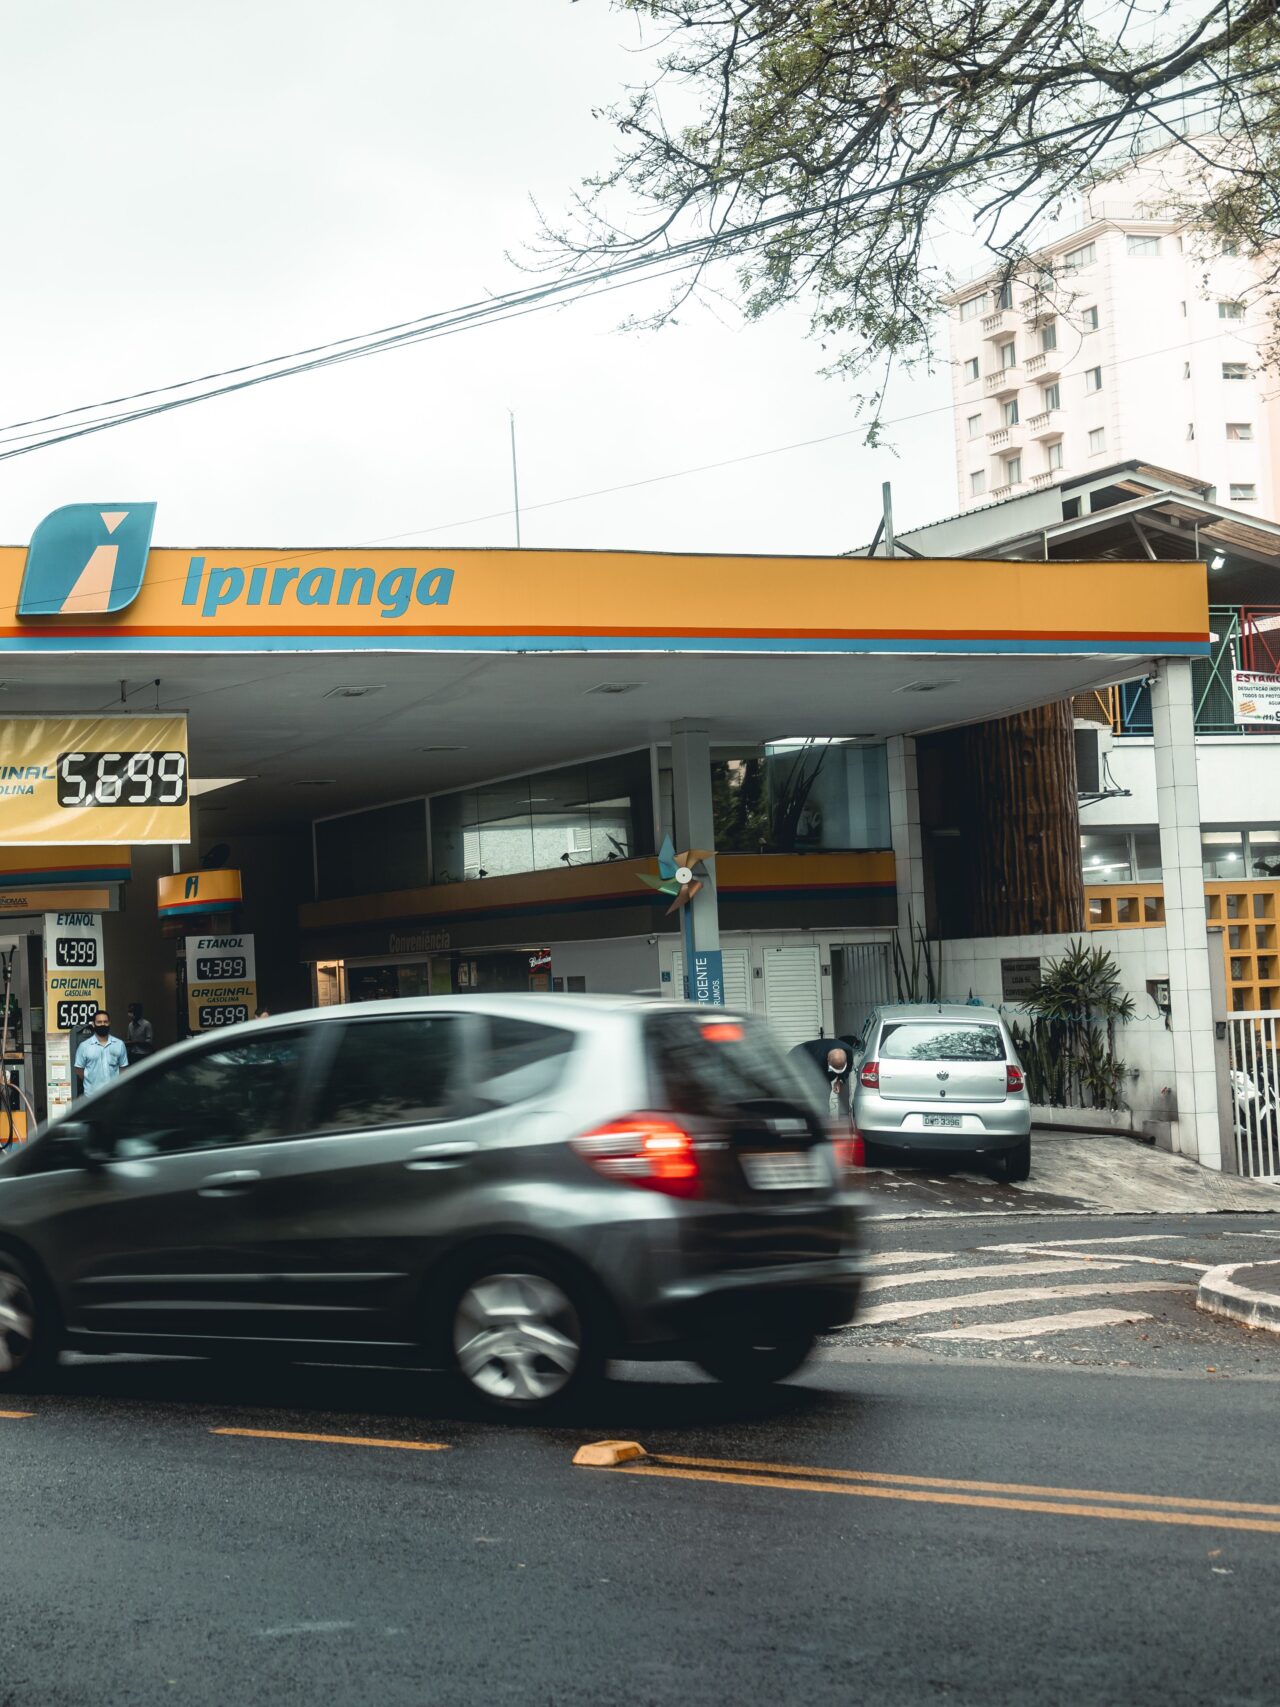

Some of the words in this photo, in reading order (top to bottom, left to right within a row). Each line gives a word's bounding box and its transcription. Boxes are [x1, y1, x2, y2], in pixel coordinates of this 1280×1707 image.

[181, 556, 456, 619] Ipiranga
[61, 752, 186, 807] 5,699
[56, 912, 95, 926] ETANOL
[58, 941, 95, 963] 4,399
[197, 938, 244, 949] ETANOL
[200, 960, 244, 978] 4,399
[50, 978, 103, 989] ORIGINAL
[192, 987, 254, 998] ORIGINAL
[202, 1007, 246, 1026] 5,699
